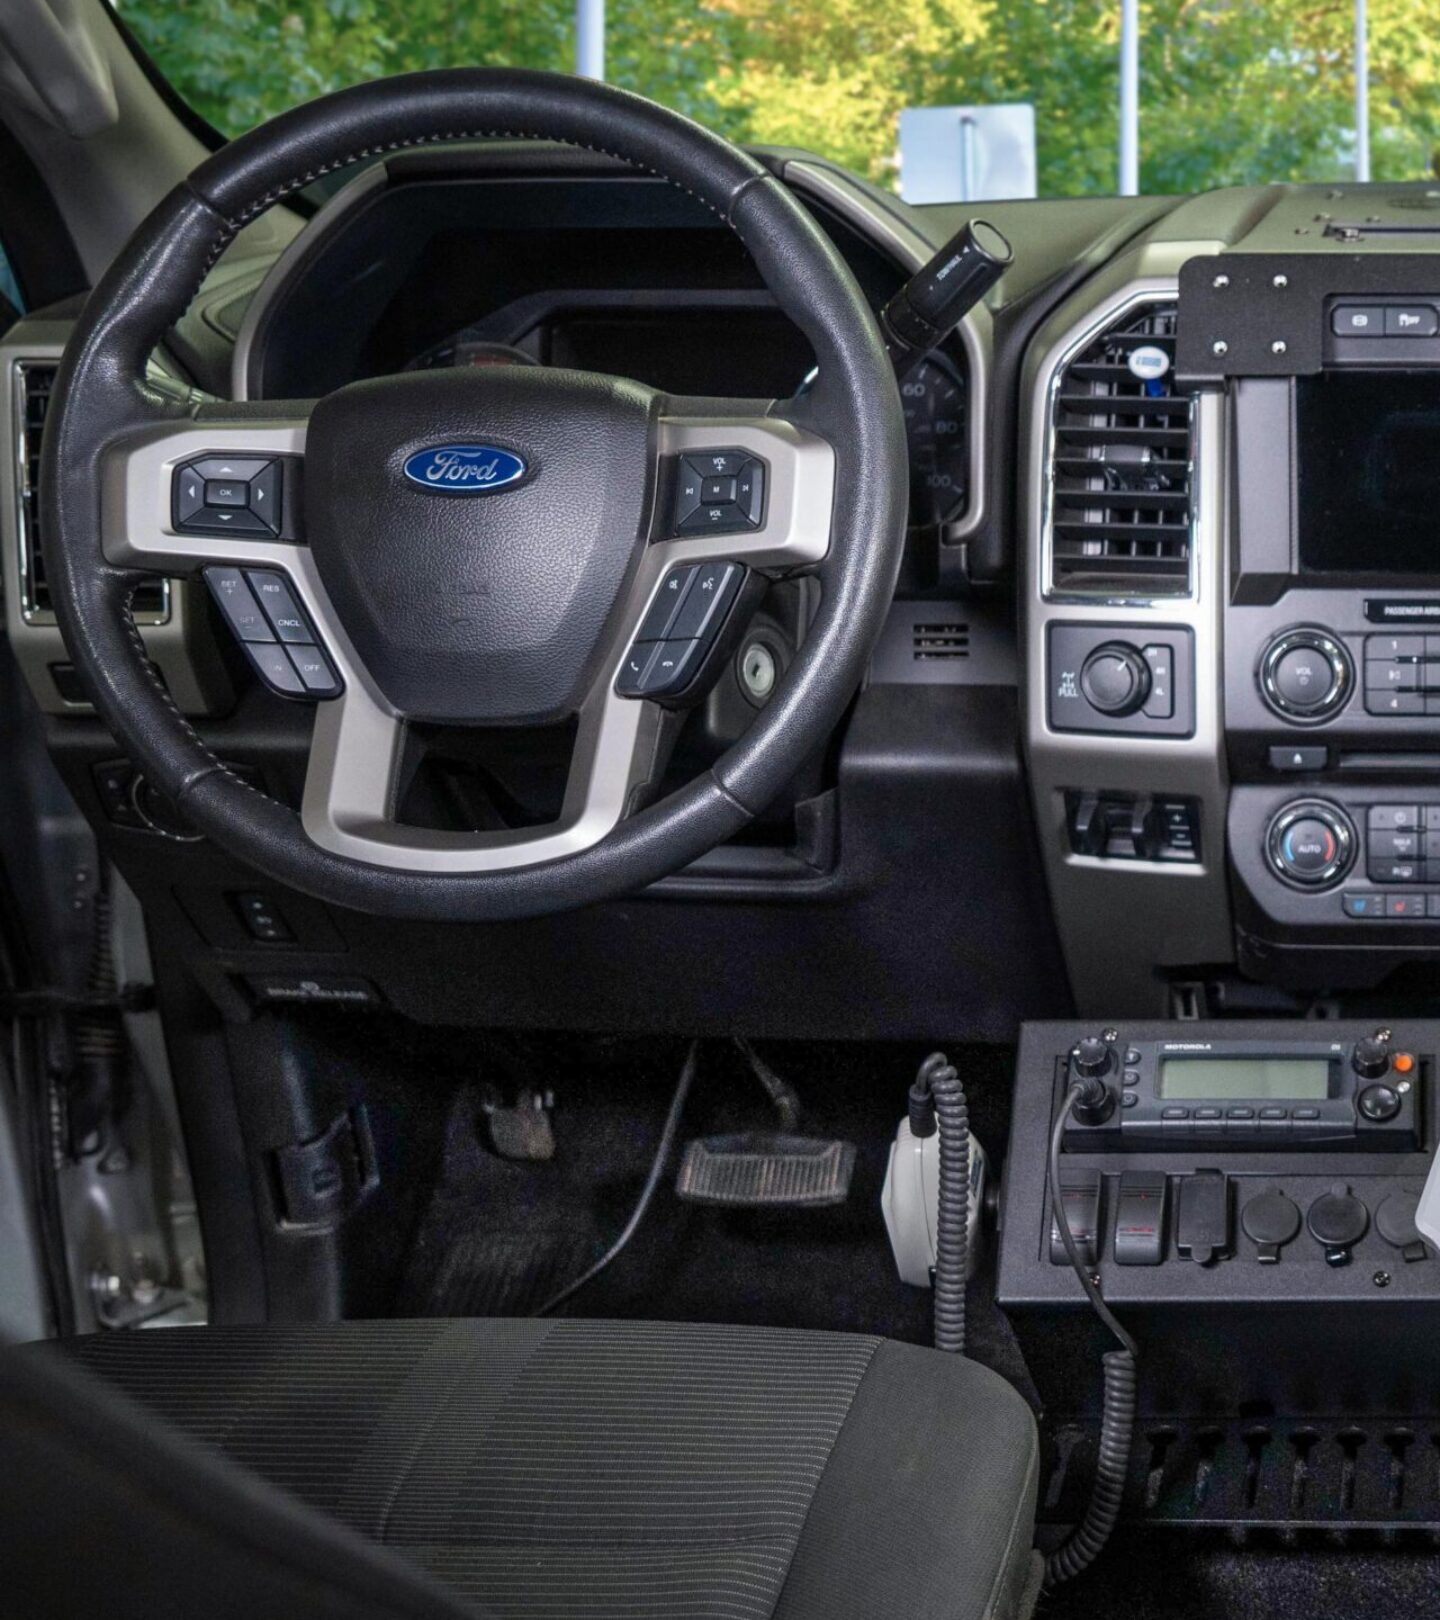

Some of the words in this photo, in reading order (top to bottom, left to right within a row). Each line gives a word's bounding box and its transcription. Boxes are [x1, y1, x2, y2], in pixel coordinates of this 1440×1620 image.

[903, 383, 926, 397] 60
[426, 451, 499, 480] Ford
[713, 457, 727, 465] VOL
[263, 584, 280, 592] RES
[1384, 606, 1423, 616] PASSENGER
[278, 619, 300, 627] CNCL
[1391, 640, 1398, 650] 1
[304, 664, 320, 672] OFF
[1296, 668, 1312, 676] VOL
[1058, 687, 1078, 697] PULL
[1391, 699, 1398, 708] 4
[1298, 844, 1321, 854] AUTO
